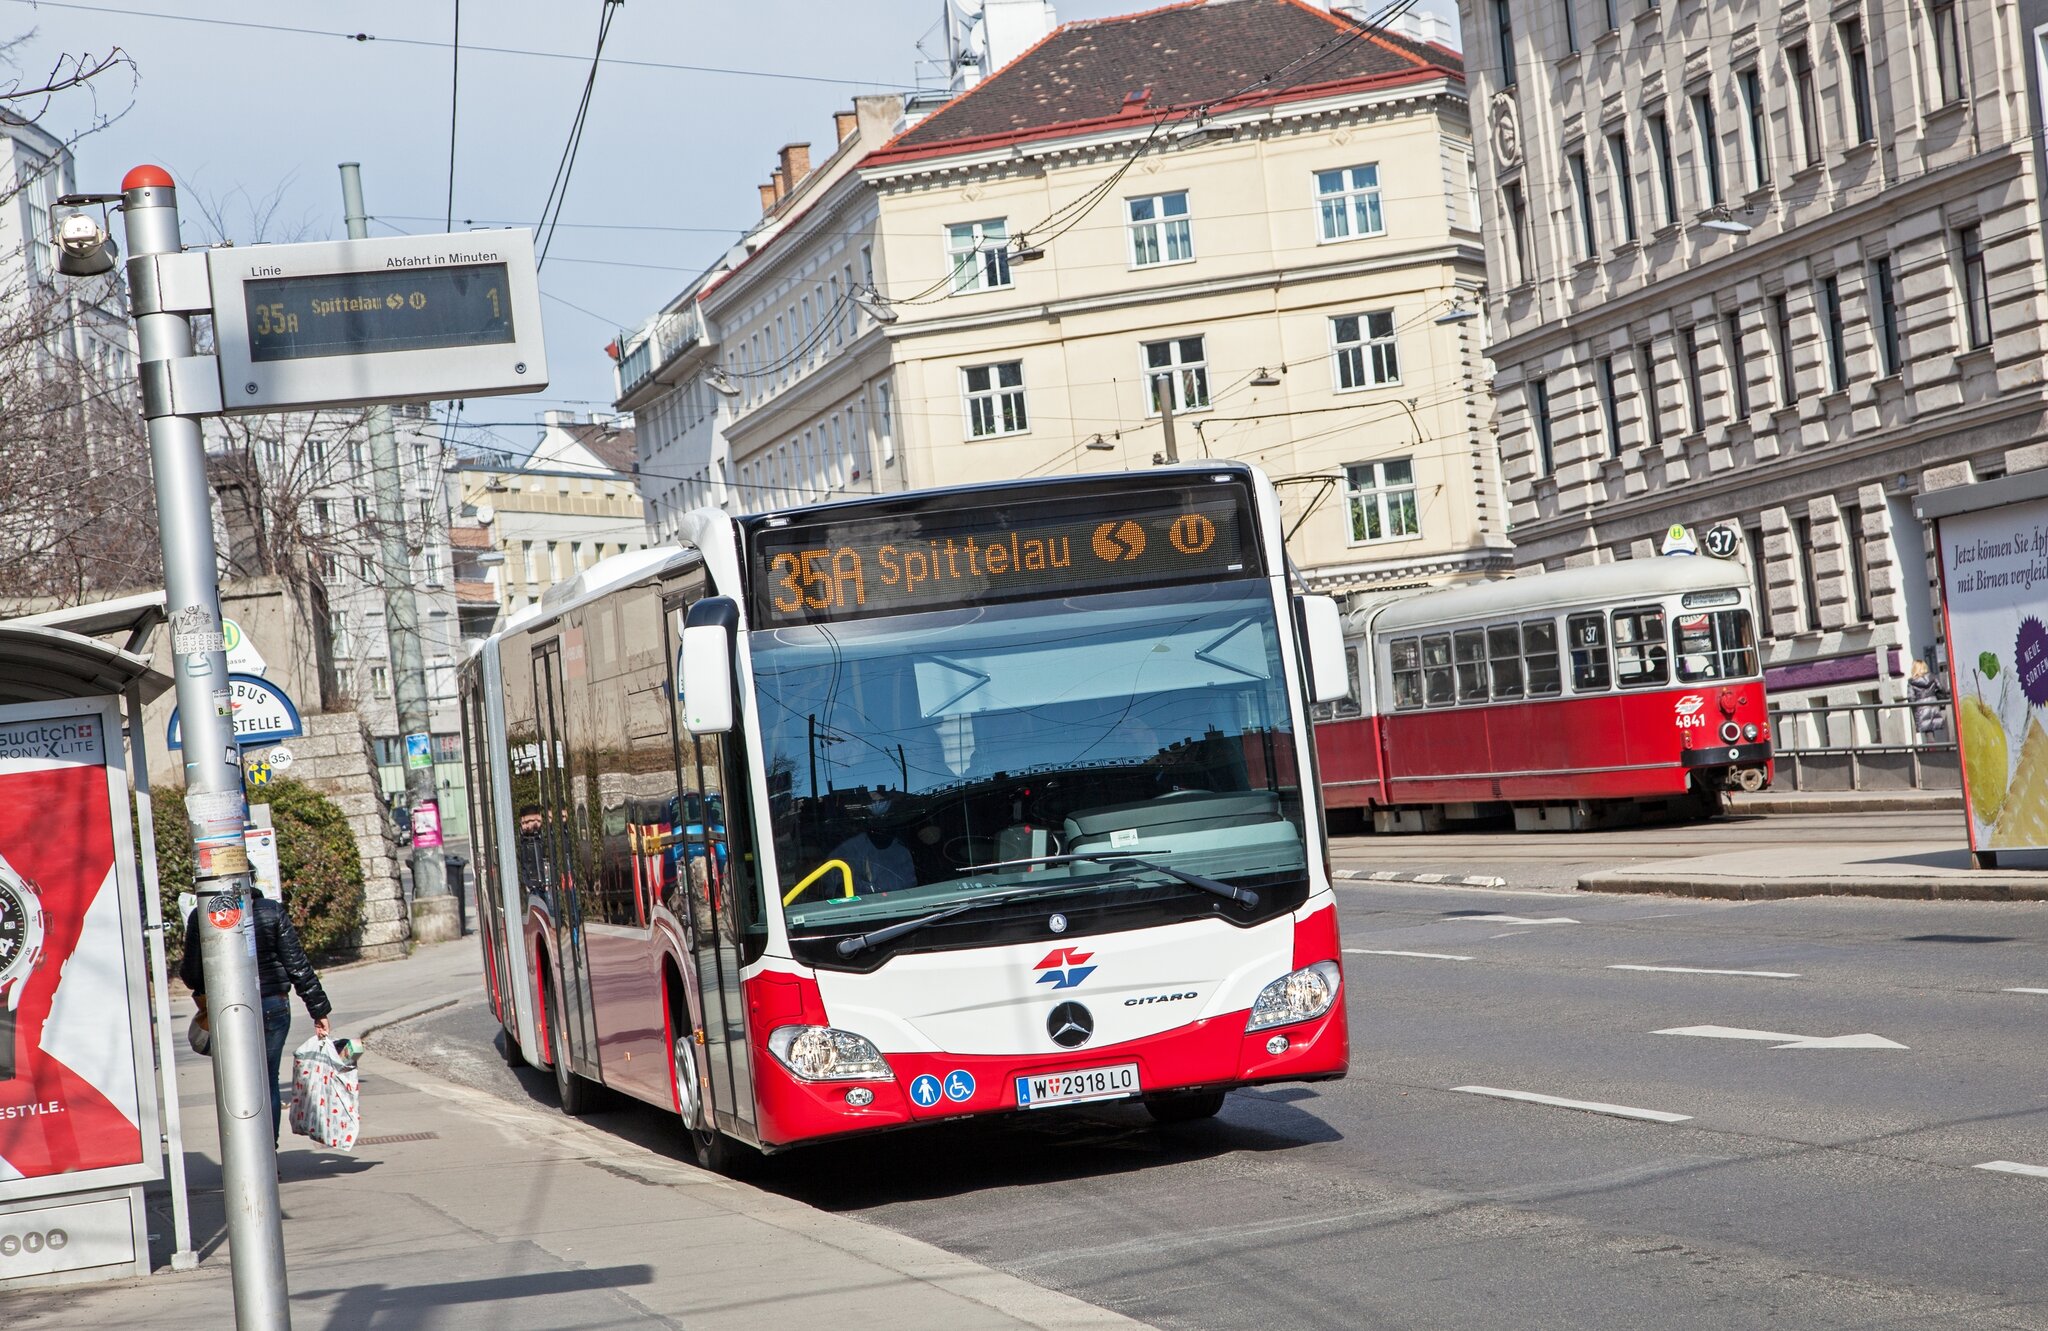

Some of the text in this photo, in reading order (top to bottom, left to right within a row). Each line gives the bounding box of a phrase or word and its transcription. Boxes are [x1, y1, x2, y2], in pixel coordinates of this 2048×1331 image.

[386, 251, 498, 268] Abfahrt in Minuten
[251, 266, 281, 277] Linie
[311, 295, 382, 317] Spittelau
[486, 288, 500, 318] 1
[255, 303, 299, 336] 35A
[1710, 530, 1732, 553] 37
[1953, 544, 1975, 571] Jetzt
[1977, 539, 2012, 561] können
[2014, 533, 2029, 555] Sie
[770, 546, 866, 612] 35A
[878, 532, 1072, 592] Spittelau
[1957, 573, 1974, 594] mit
[1976, 570, 2009, 591] Birnen
[1585, 626, 1597, 642] 37
[2024, 640, 2041, 664] NEUE
[1675, 713, 1706, 728] 4841
[0, 724, 77, 747] swatch
[270, 753, 292, 764] 35A
[253, 769, 267, 785] N
[1124, 991, 1198, 1007] CITARO
[1034, 1069, 1132, 1099] W 2918 LO
